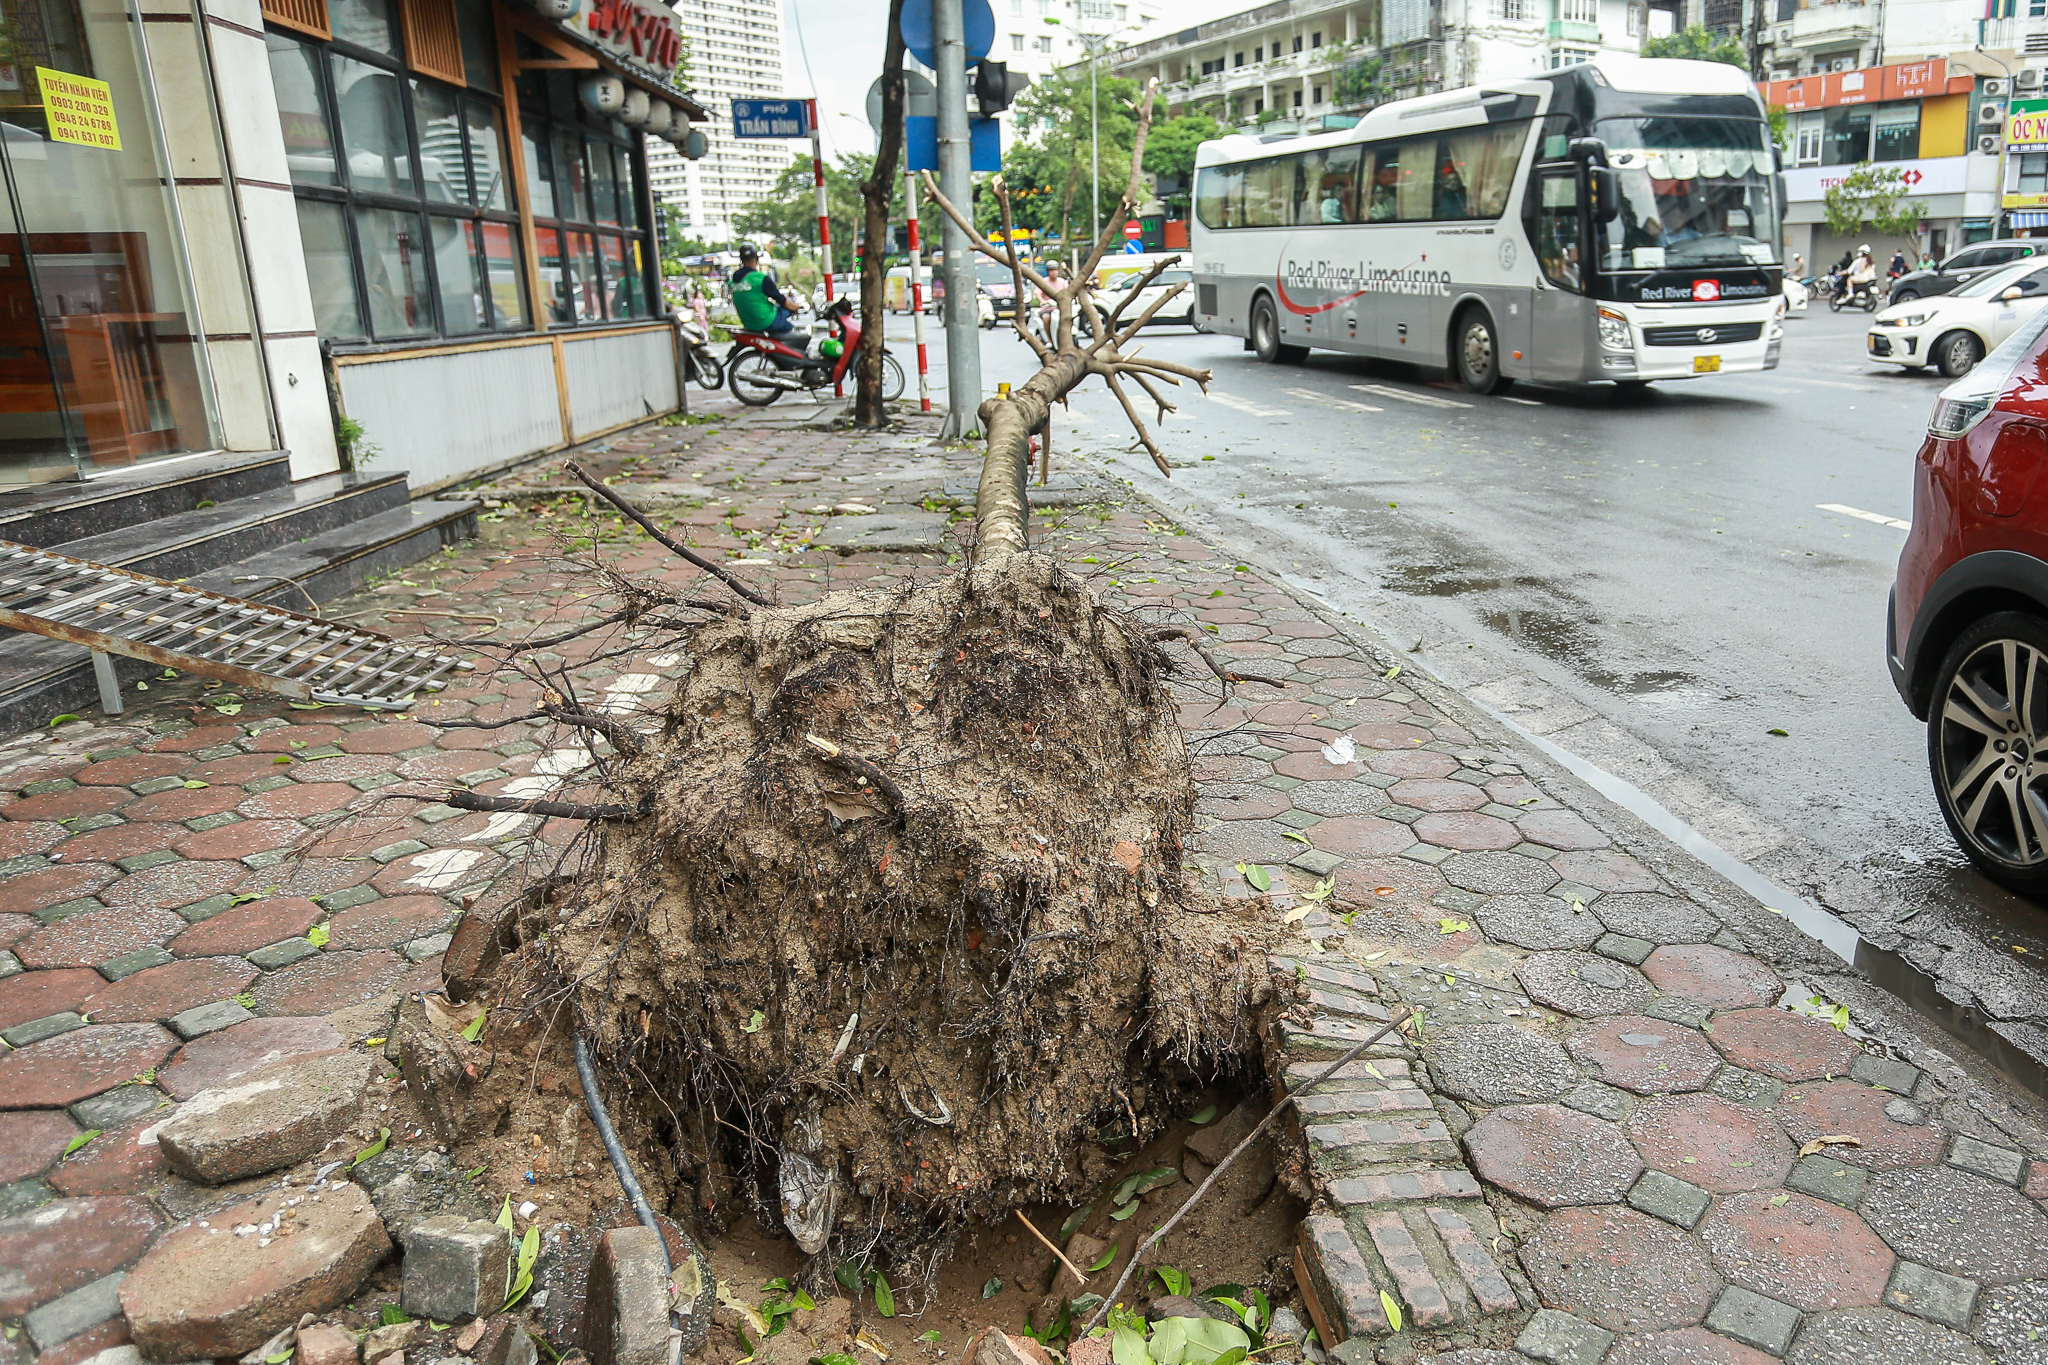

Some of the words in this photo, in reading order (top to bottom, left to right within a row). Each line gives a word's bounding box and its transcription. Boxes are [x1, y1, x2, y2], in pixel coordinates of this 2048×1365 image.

[43, 77, 69, 94] TUYỂN
[69, 83, 91, 98] NHÂN
[91, 87, 108, 102] VIÊN
[51, 96, 73, 109] 0903
[75, 101, 91, 113] 200
[93, 104, 109, 116] 329
[762, 103, 788, 114] PHỐ
[54, 112, 77, 124] 0948
[78, 115, 89, 126] 24
[91, 118, 111, 131] 6789
[771, 117, 799, 135] BÌNH
[2034, 118, 2048, 140] N
[58, 127, 79, 140] 0941
[82, 131, 97, 143] 631
[99, 134, 114, 145] 807
[1287, 260, 1314, 289] Red
[1317, 260, 1354, 290] River
[1359, 261, 1452, 297] Limousine
[1641, 287, 1663, 300] Red
[1664, 286, 1692, 299] River
[1720, 284, 1767, 296] Limousine
